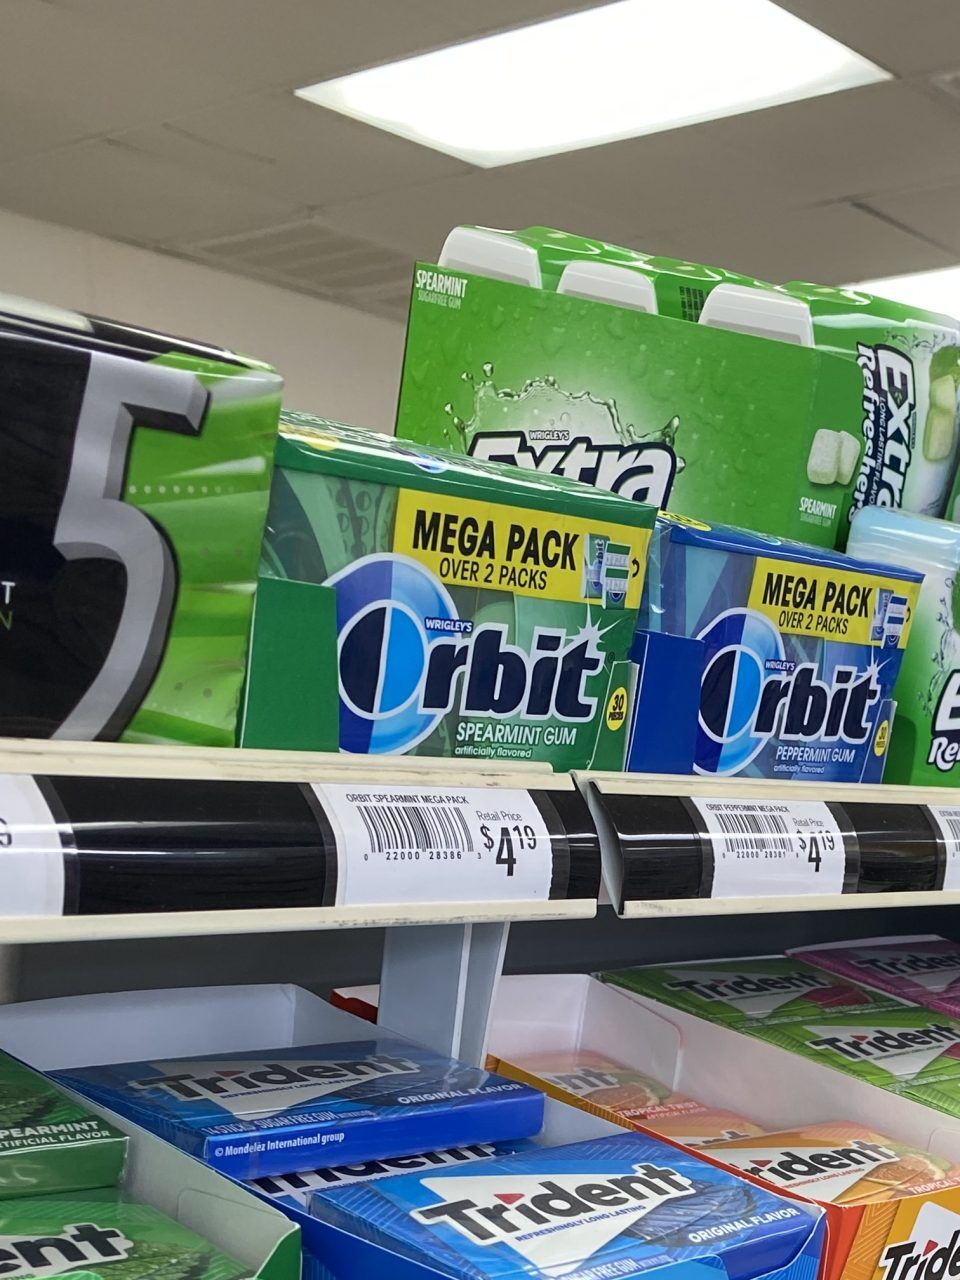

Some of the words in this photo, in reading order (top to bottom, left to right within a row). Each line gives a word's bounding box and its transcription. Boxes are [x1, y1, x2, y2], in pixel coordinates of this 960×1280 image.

[415, 270, 467, 298] SPEARMINT
[529, 430, 569, 441] WRIGLEY'S
[874, 345, 915, 509] Extra
[799, 497, 837, 520] SPEARMINT
[412, 509, 495, 560] MEGA
[506, 524, 579, 571] PACK
[439, 557, 479, 583] OVER
[483, 564, 493, 584] 2
[499, 566, 547, 590] PACKS
[762, 572, 818, 611] MEGA
[822, 581, 873, 618] PACK
[425, 617, 473, 633] WRIGLEY'S
[778, 611, 803, 629] OVER
[805, 616, 813, 630] 2
[815, 617, 849, 635] PACKS
[338, 599, 604, 722] Orbit
[765, 660, 796, 671] WRIGLEY'S
[611, 692, 625, 711] 30
[699, 645, 881, 744] Orbit
[456, 722, 542, 745] SPEARMINT
[544, 727, 577, 746] GUM
[455, 746, 495, 758] artificially
[497, 748, 531, 758] flavored
[776, 746, 831, 763] PEPPERMINT
[832, 748, 855, 763] GUM
[346, 793, 371, 803] ORBIT
[373, 794, 420, 804] SPEARMINT
[421, 795, 444, 804] MEGA
[445, 795, 469, 805] PACK
[476, 810, 500, 821] Retail
[501, 811, 522, 822] Price
[667, 971, 824, 1000] Trident
[140, 1054, 418, 1100] Trident
[397, 1087, 466, 1105] ORIGINAL
[468, 1082, 524, 1098] FLAVOR
[618, 1105, 667, 1119] TROPICAL
[0, 1121, 98, 1138] PEARMINT
[267, 1133, 320, 1151] International
[321, 1131, 345, 1145] group
[735, 1139, 890, 1186] rident
[908, 1178, 957, 1195] TROPICAL
[420, 1163, 691, 1242] Trident
[514, 1217, 583, 1244] REFRESHINGLY
[583, 1212, 610, 1228] LONG
[610, 1204, 647, 1221] LASTING
[687, 1220, 751, 1244] ORIGINAL
[751, 1207, 801, 1227] FLAVOR
